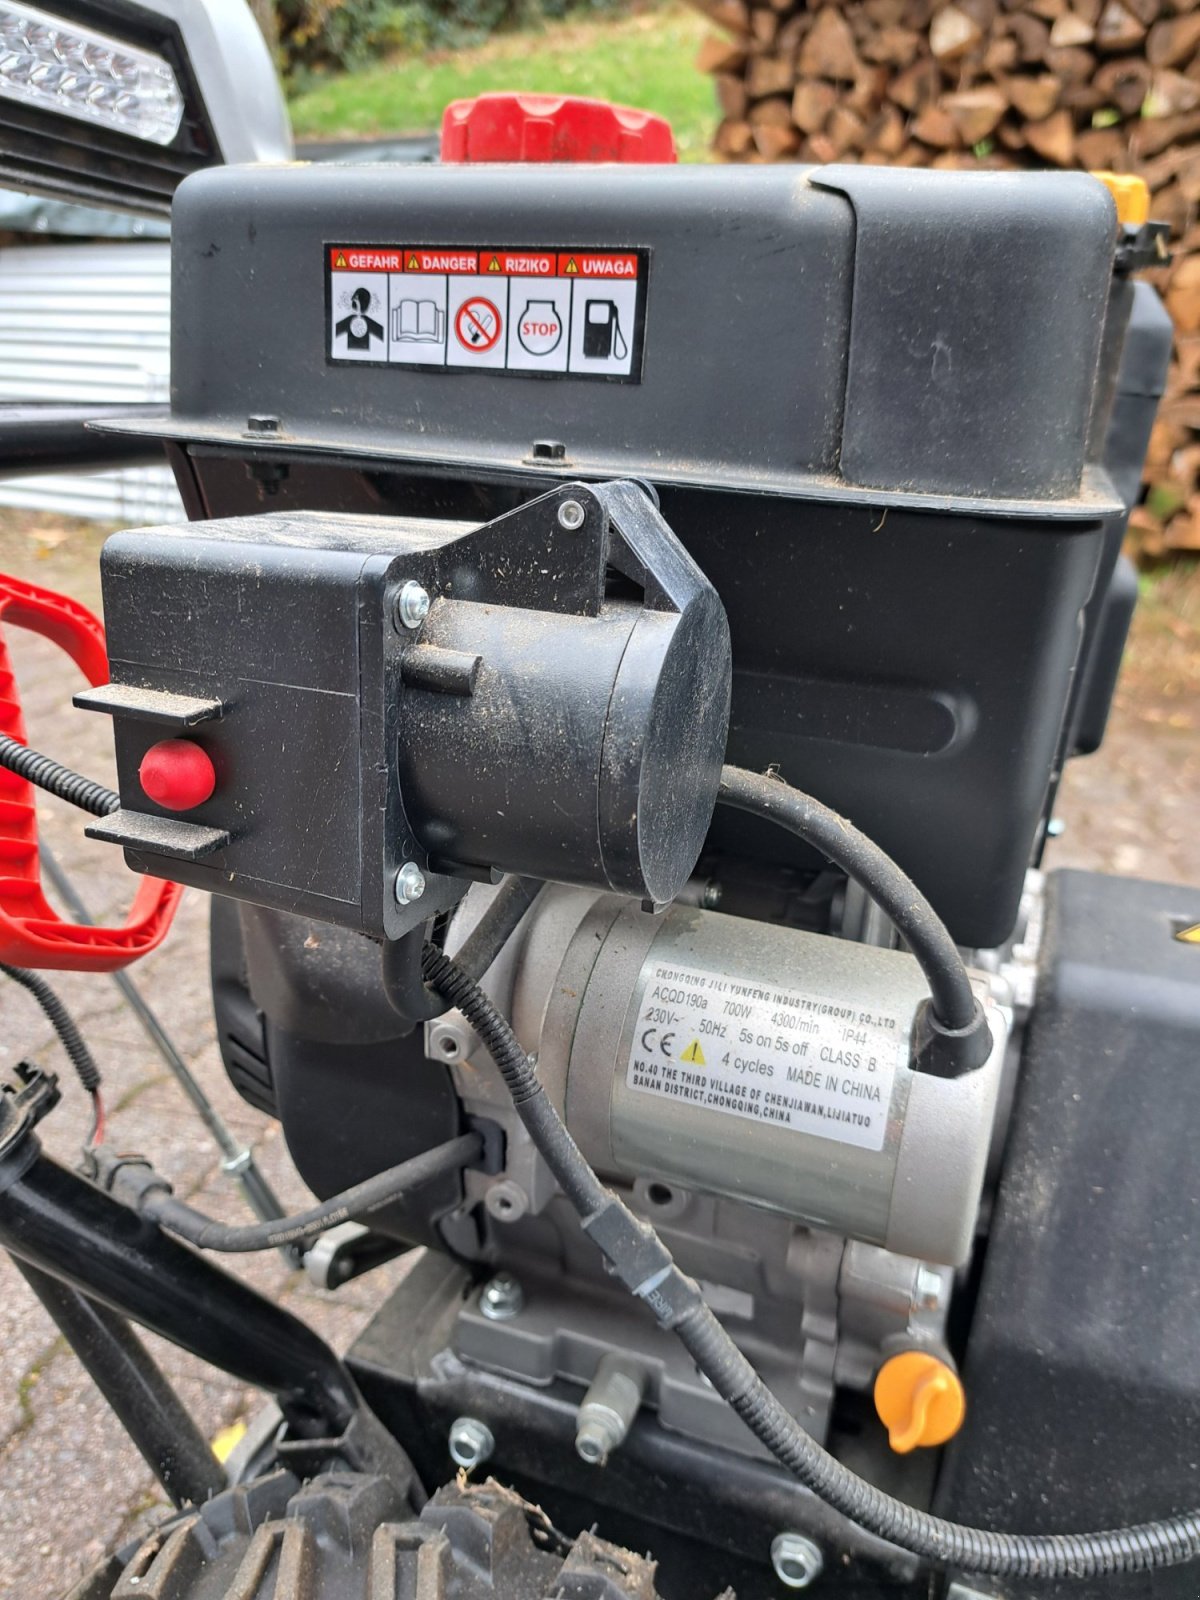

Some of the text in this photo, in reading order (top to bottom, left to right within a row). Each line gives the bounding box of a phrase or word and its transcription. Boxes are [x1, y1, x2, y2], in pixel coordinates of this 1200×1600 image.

[349, 255, 634, 275] GEFAHR DANGER RIZIKO UWAGA
[523, 322, 557, 336] STOP
[652, 986, 867, 1046] ACQD190a 700W 4300/min IP44
[708, 980, 727, 992] JILI
[730, 984, 770, 1002] YUNFENG
[773, 994, 856, 1022] INDUSTRY(GROUP)
[699, 1019, 727, 1038] 50Hz
[739, 1028, 753, 1044] 5s
[756, 1036, 771, 1049] on
[775, 1036, 789, 1052] 5s
[792, 1041, 810, 1056] off
[820, 1046, 861, 1068] CLASS
[868, 1057, 877, 1072] B
[633, 1060, 658, 1076] NO.40
[662, 1067, 678, 1080] THE
[681, 1072, 707, 1087] THIRD
[710, 1079, 747, 1098] VILLAGE
[750, 1088, 761, 1101] OF
[633, 1075, 661, 1091] BANAN
[722, 1052, 880, 1102] 4 cycles MADE IN CHINA
